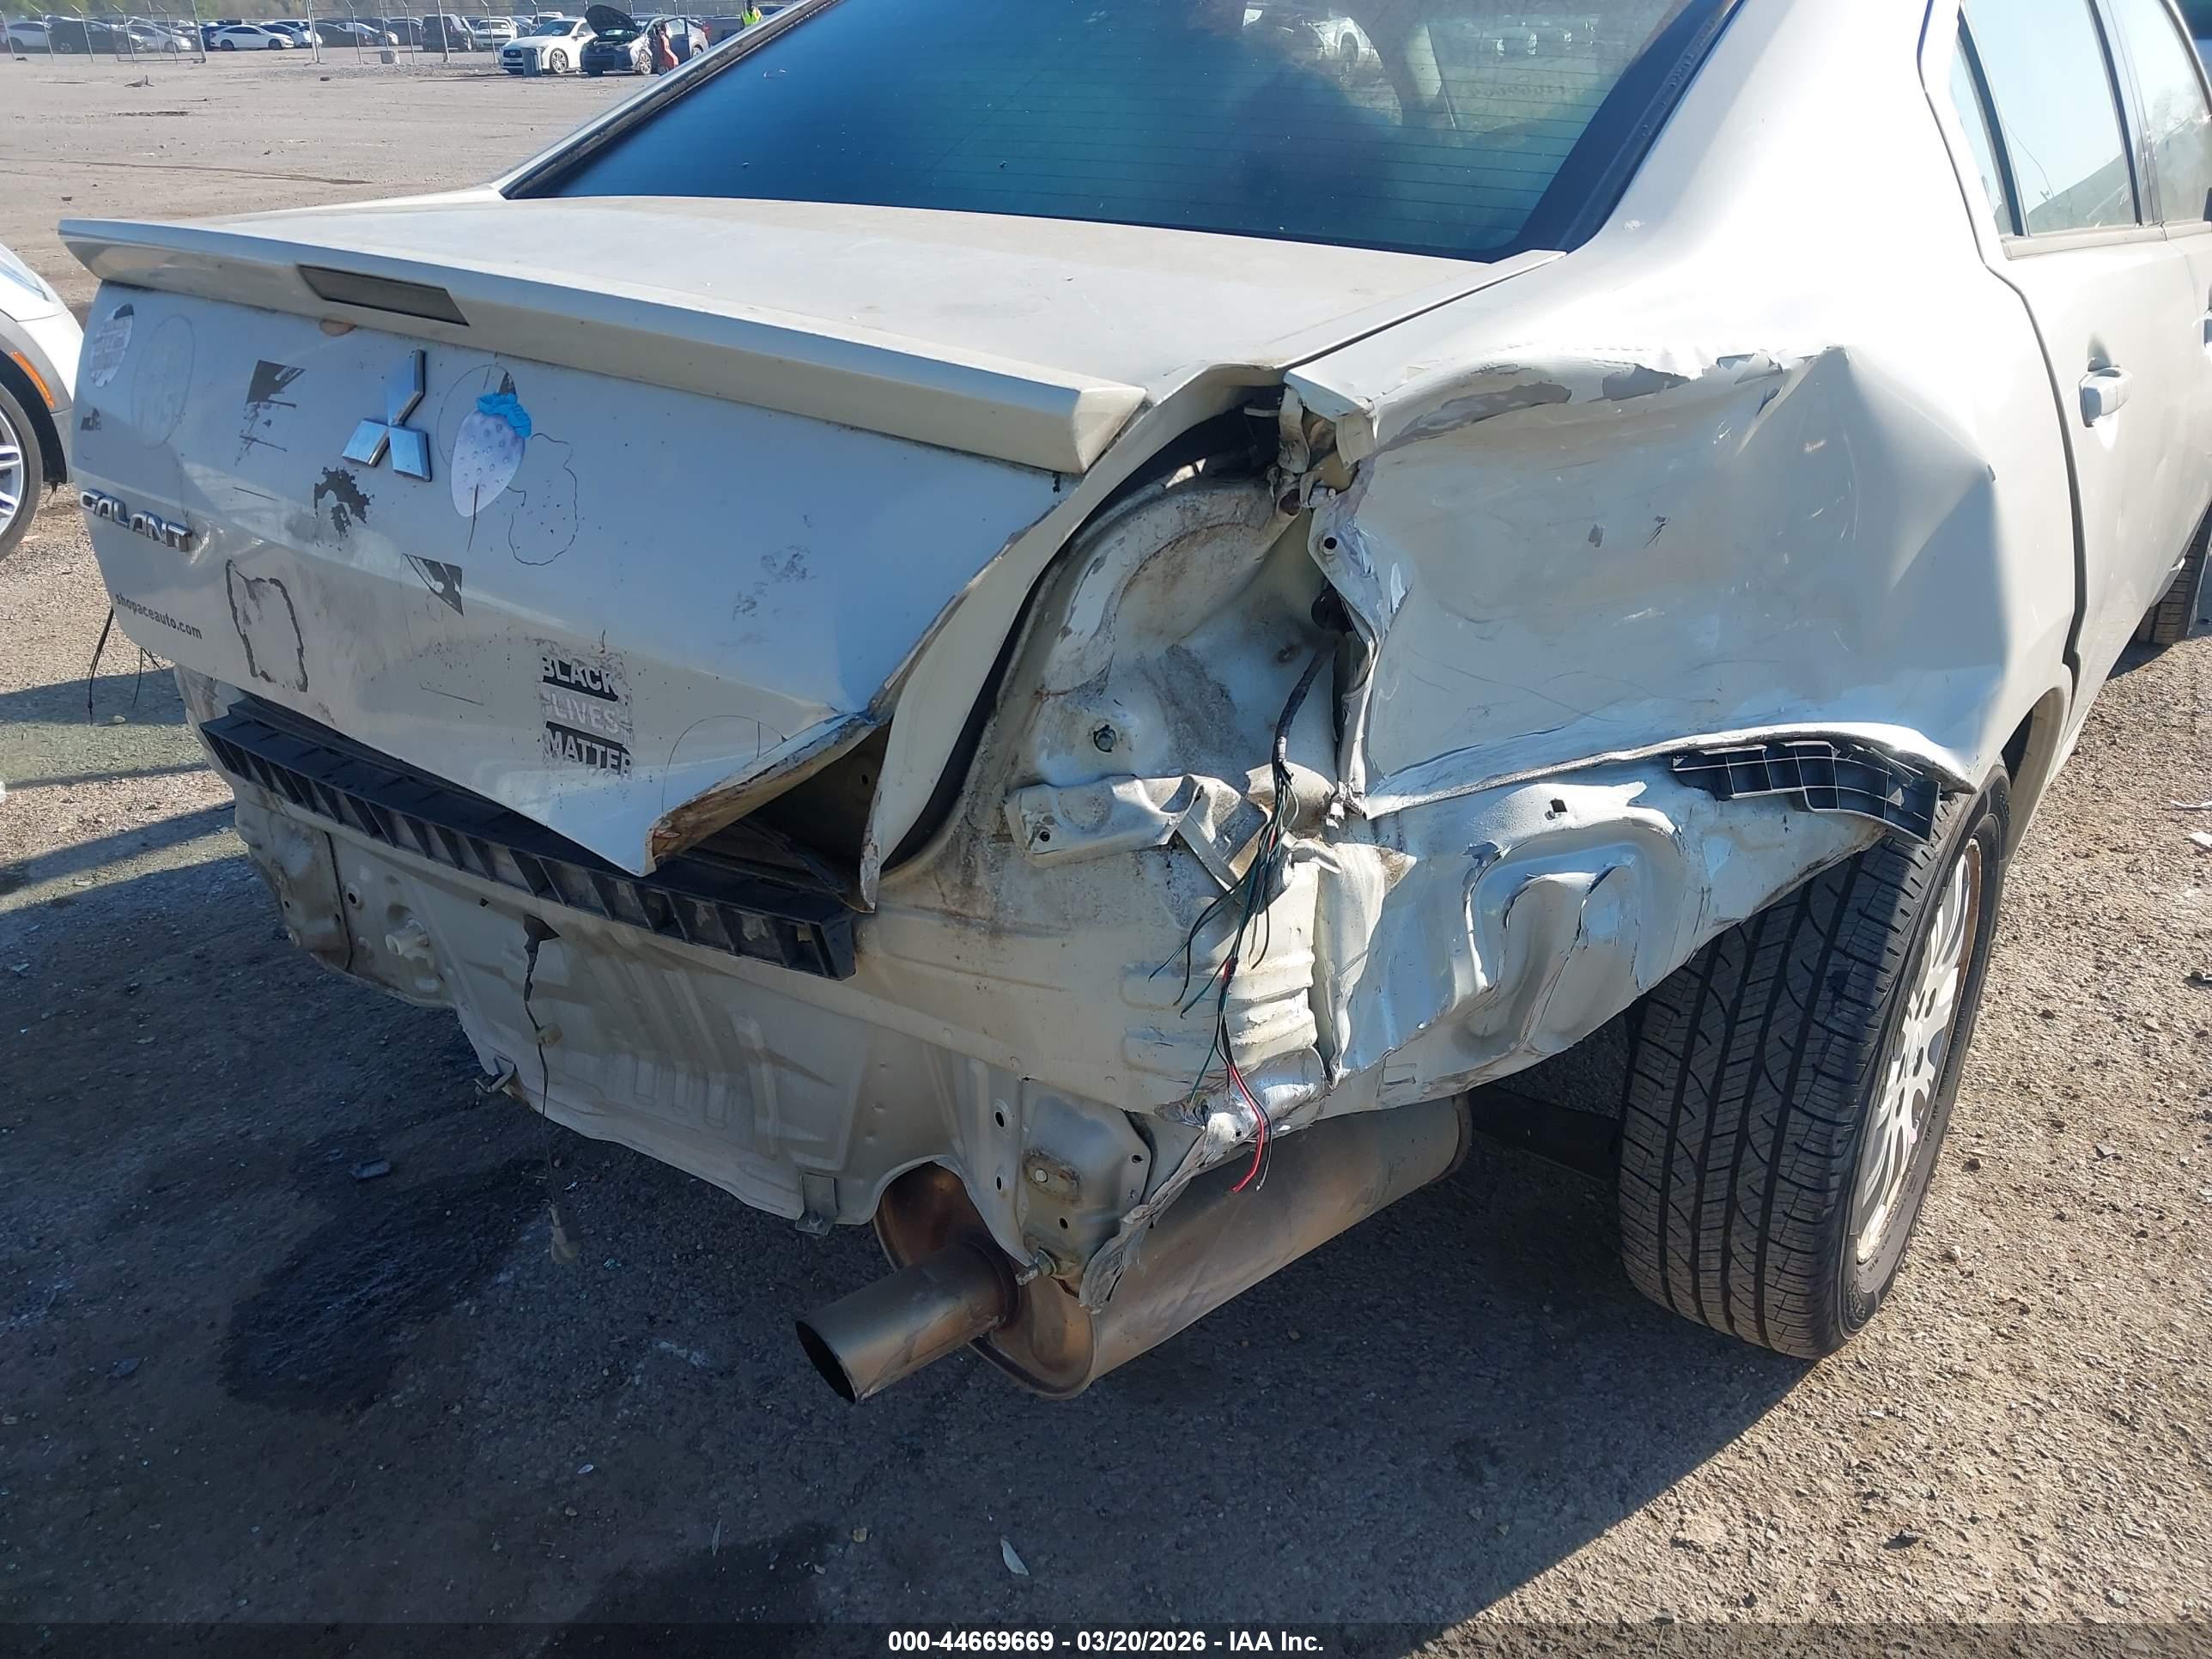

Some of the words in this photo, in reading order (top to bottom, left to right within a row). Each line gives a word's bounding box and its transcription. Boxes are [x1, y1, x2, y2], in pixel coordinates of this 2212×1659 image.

[80, 489, 191, 552] GALANT
[115, 592, 203, 640] shopaceauto.com
[540, 655, 618, 696] BLACK
[551, 693, 620, 734] LIVES
[543, 730, 634, 781] MATTER
